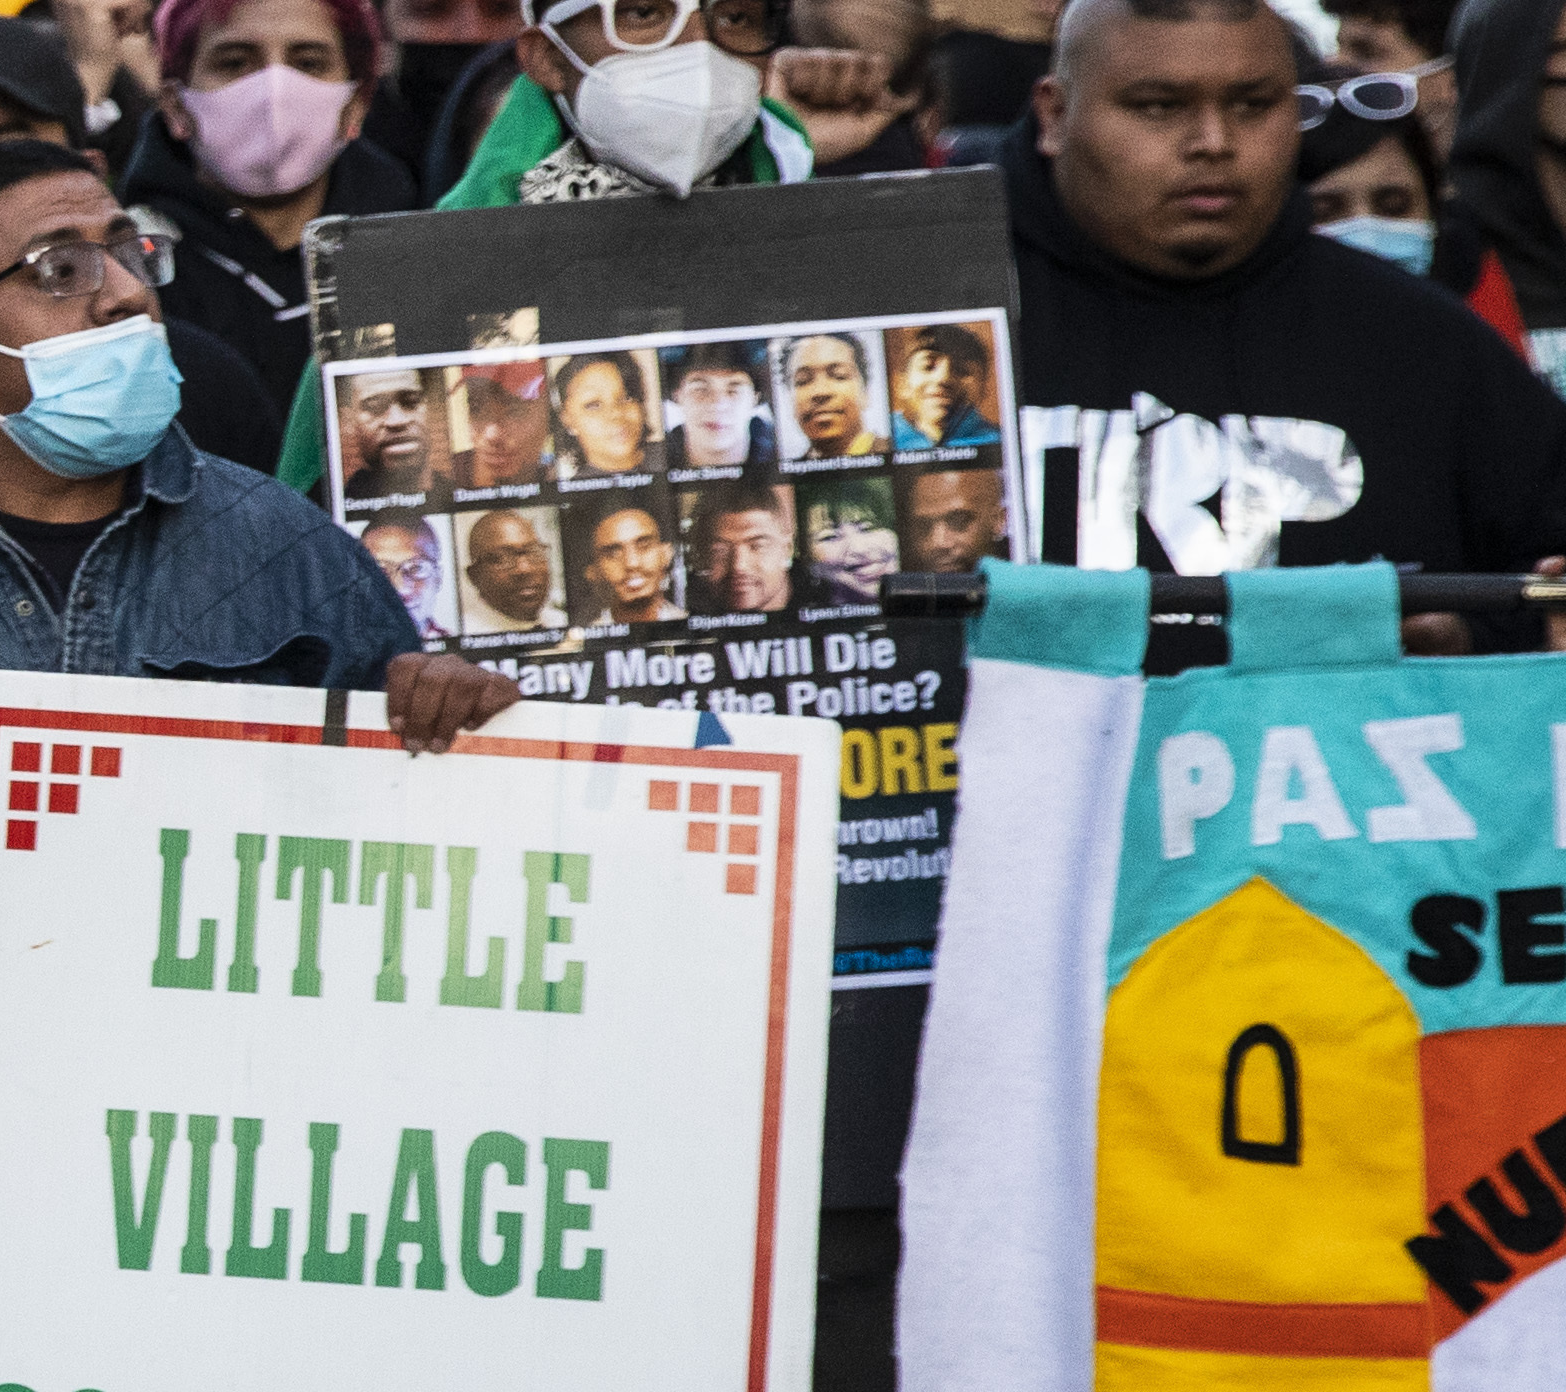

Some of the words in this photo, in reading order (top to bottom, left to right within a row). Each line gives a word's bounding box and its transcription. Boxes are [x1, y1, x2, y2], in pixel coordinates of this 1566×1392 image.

[605, 644, 717, 689] More
[725, 633, 813, 681] Will
[823, 631, 898, 674] Die
[786, 669, 943, 718] Police?
[840, 723, 962, 800] ORE
[1156, 713, 1479, 862] PAZ
[150, 827, 588, 1013] LITTLE
[106, 1110, 608, 1301] VILLAGE
